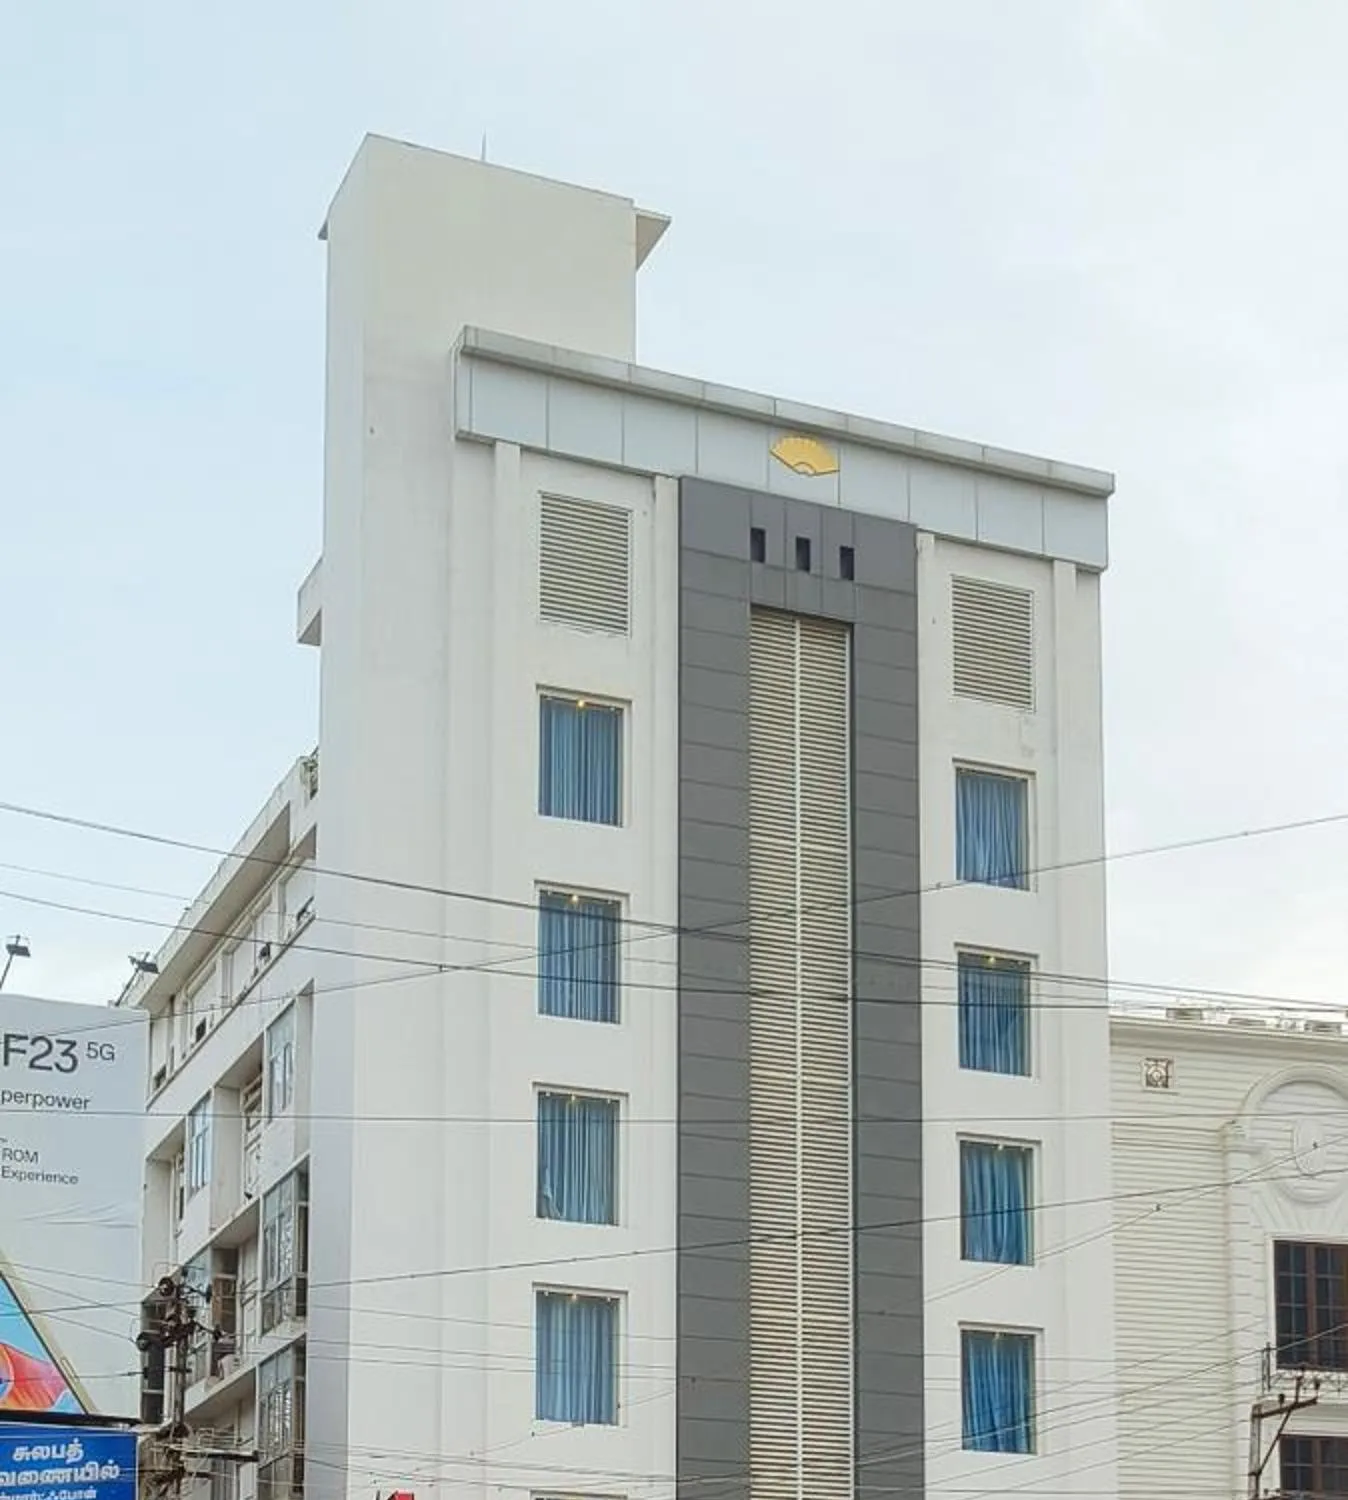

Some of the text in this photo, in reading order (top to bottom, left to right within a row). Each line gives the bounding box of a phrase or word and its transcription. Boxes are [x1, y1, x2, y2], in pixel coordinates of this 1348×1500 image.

[3, 1033, 116, 1074] F23 5G
[1, 1089, 91, 1111] perpower
[2, 1147, 39, 1164] ROM
[1, 1165, 79, 1185] Experience
